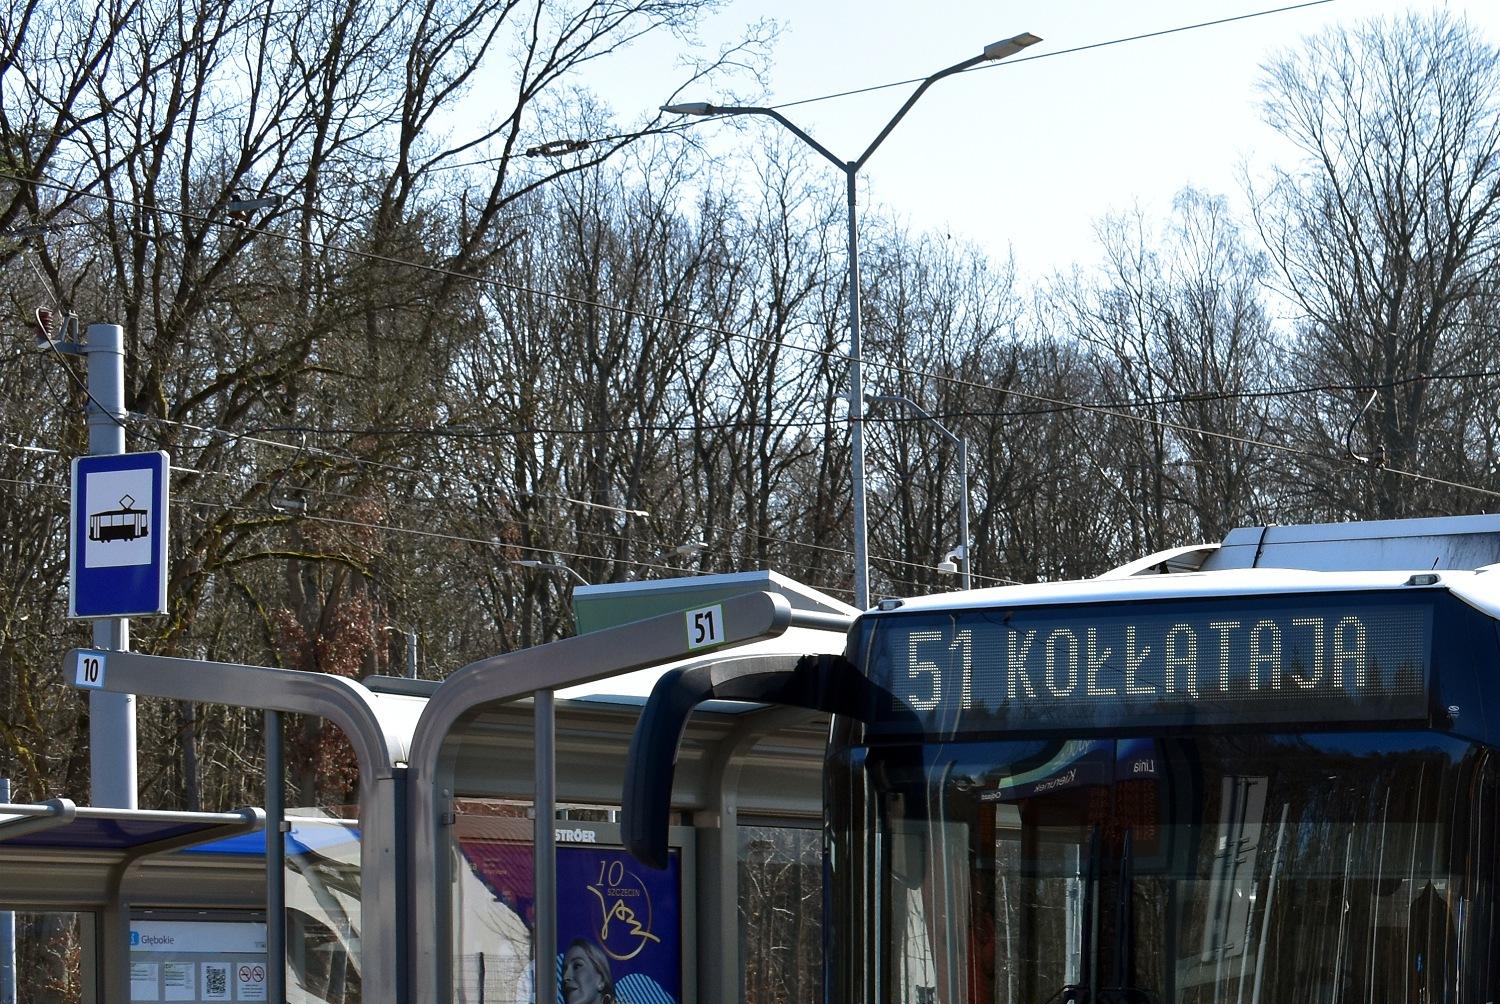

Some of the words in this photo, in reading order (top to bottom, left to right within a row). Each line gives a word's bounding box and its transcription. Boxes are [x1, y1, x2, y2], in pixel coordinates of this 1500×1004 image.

[695, 611, 715, 643] 51
[83, 658, 99, 682] 10
[908, 629, 972, 711] 51
[596, 860, 624, 887] 10
[141, 935, 175, 945] Głębokie
